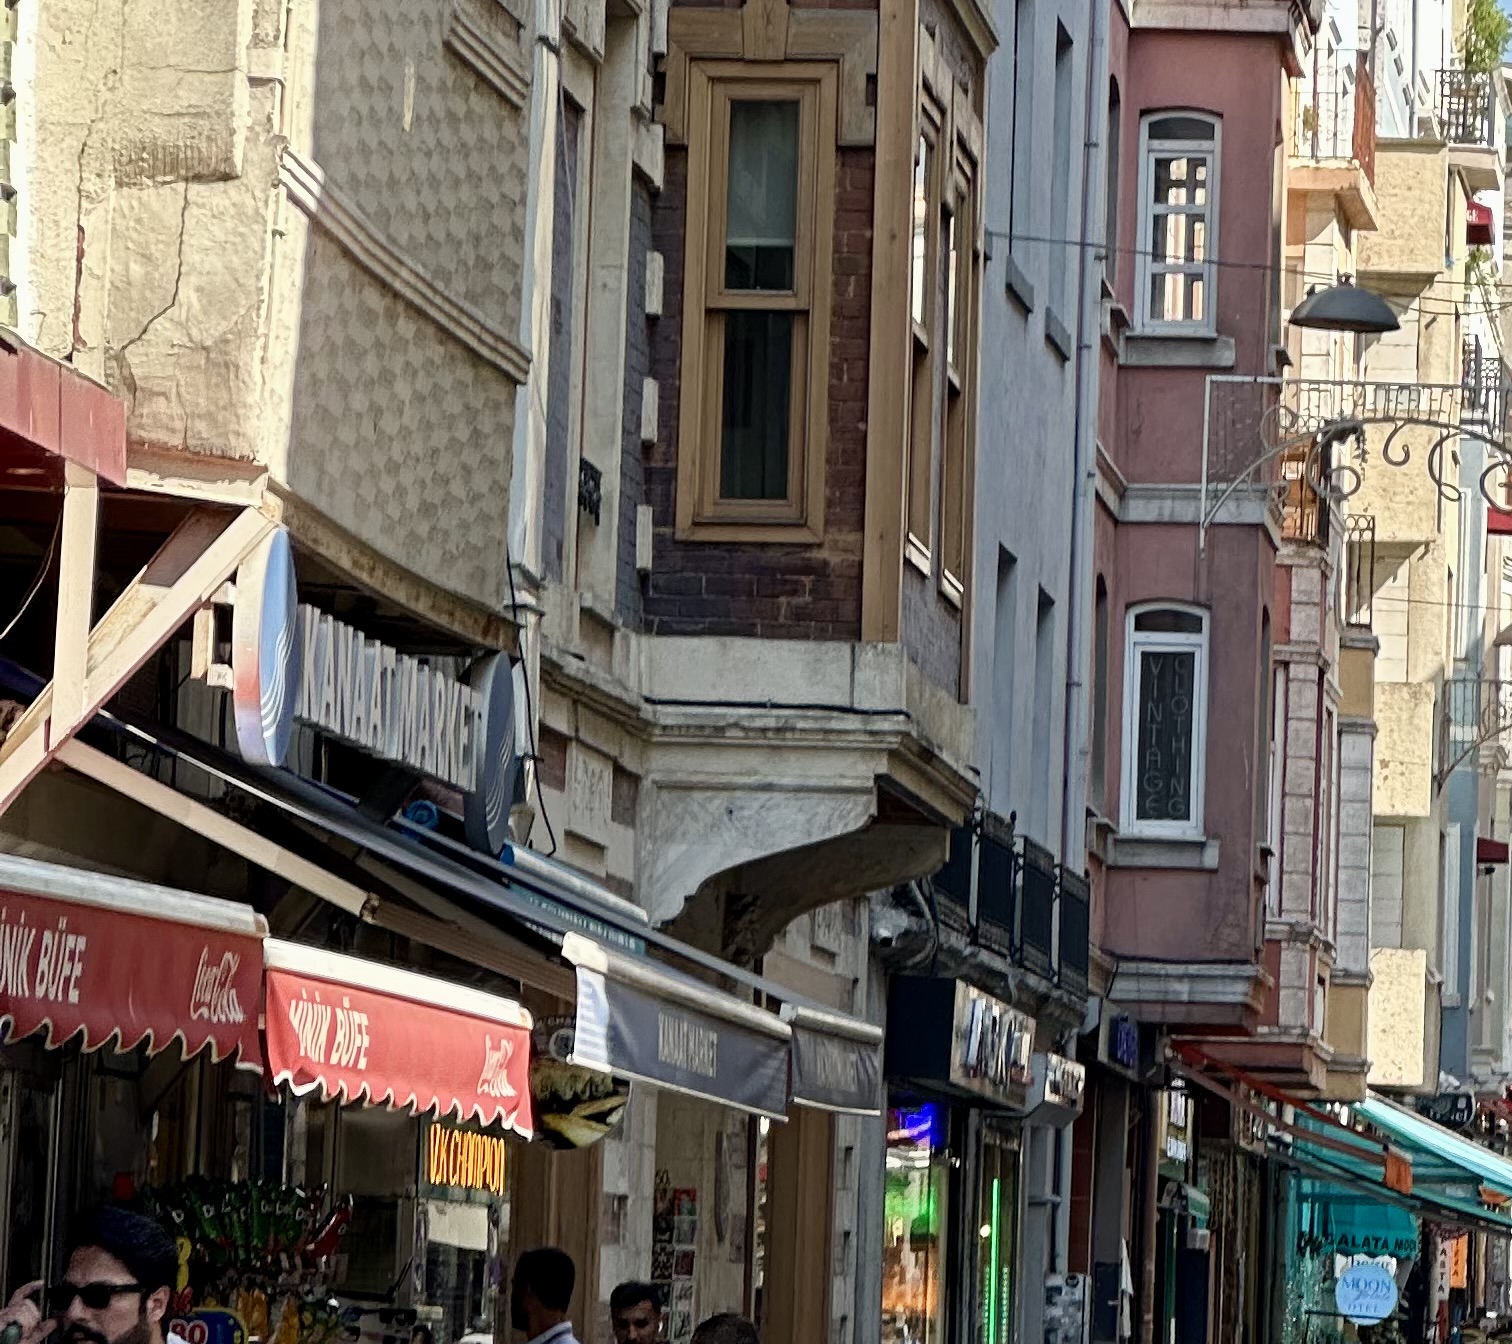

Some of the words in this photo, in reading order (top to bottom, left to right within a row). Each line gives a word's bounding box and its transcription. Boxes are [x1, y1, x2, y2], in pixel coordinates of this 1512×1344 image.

[295, 603, 397, 756] KANAAT
[398, 654, 482, 793] MARKET
[35, 916, 87, 1004] BÜFE
[329, 996, 370, 1070] BÜFE
[449, 1130, 505, 1197] CHAMPION
[1341, 1276, 1391, 1294] MOON
